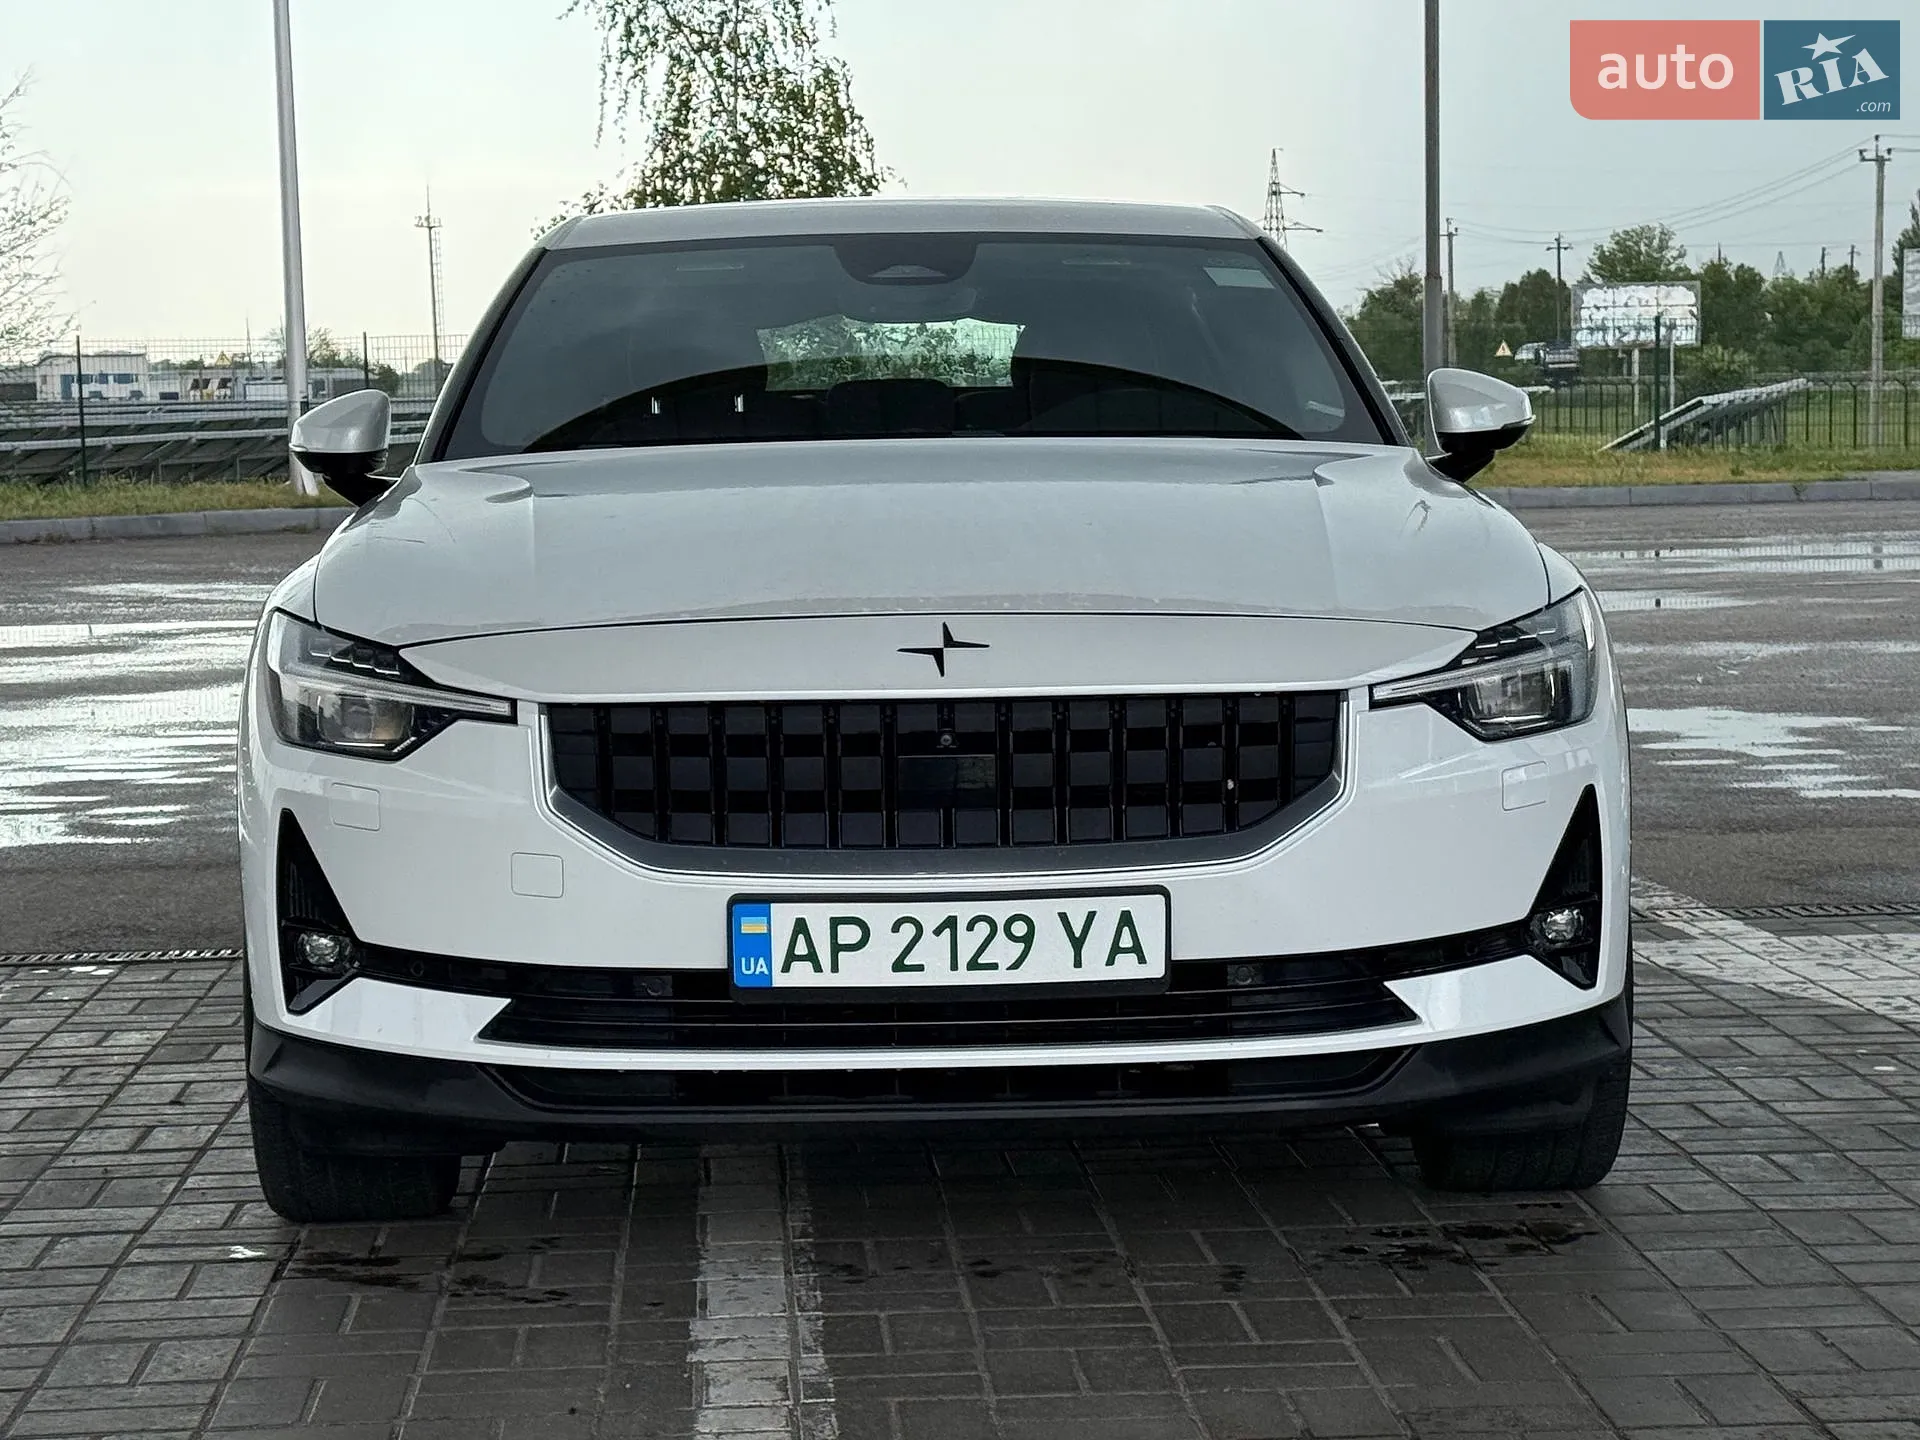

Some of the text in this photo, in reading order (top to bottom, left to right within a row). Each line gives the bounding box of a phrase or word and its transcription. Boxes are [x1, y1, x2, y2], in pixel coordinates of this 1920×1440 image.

[780, 910, 1148, 974] AP 2129 YA
[741, 958, 769, 975] UA
